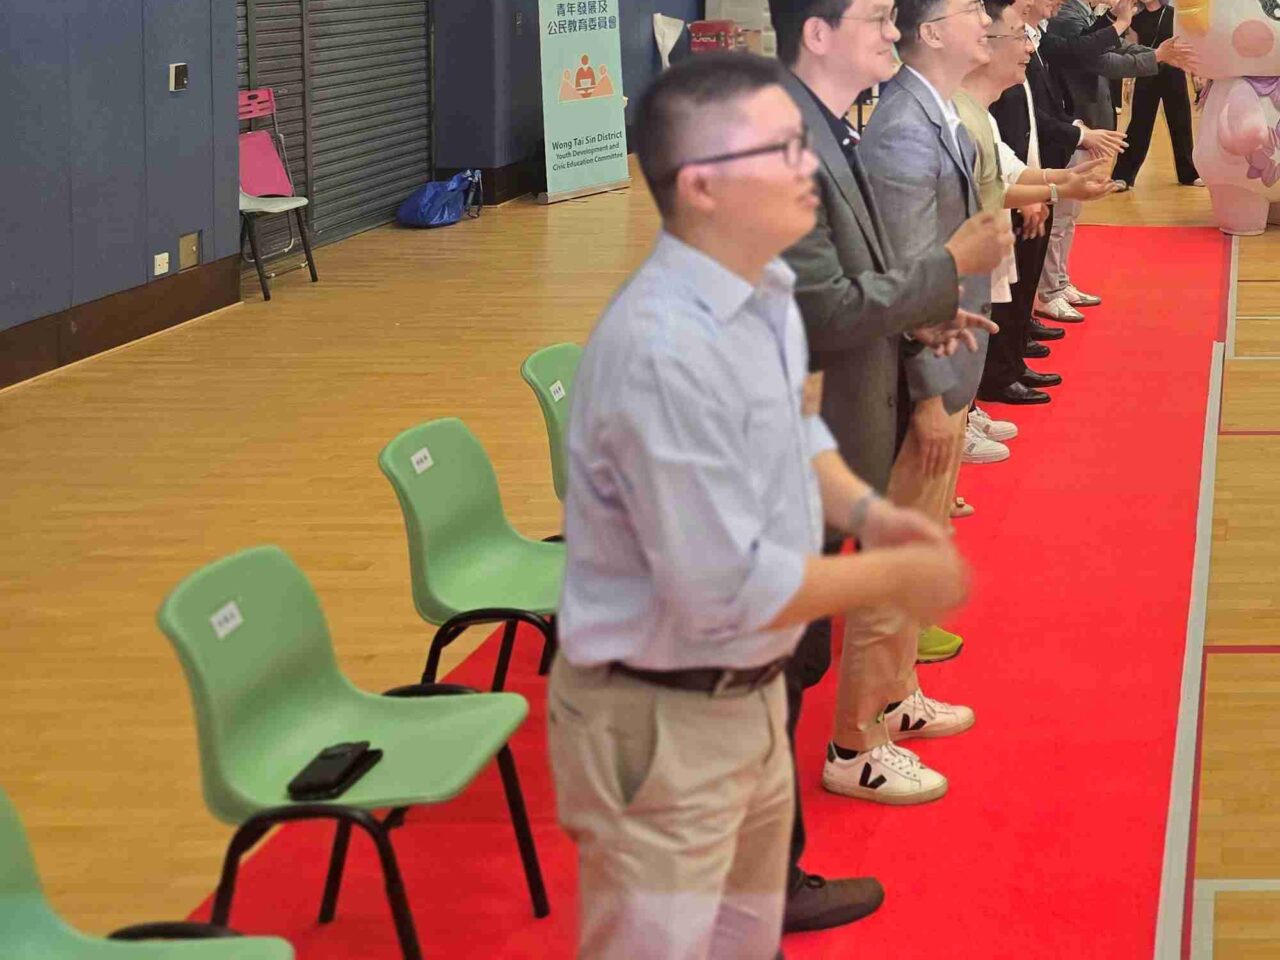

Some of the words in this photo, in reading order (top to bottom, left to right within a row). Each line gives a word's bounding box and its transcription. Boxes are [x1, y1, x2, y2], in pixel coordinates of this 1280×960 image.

[556, 0, 608, 17] 青年發展及
[547, 15, 617, 35] 公民教育委員會
[552, 141, 572, 150] Wong
[573, 137, 584, 146] Tai
[585, 136, 596, 145] Sin
[597, 131, 623, 142] District
[556, 151, 572, 160] Youth
[572, 145, 608, 157] Development
[609, 142, 620, 150] and
[552, 163, 566, 171] Civic
[566, 158, 594, 168] Education
[594, 152, 623, 163] Committee
